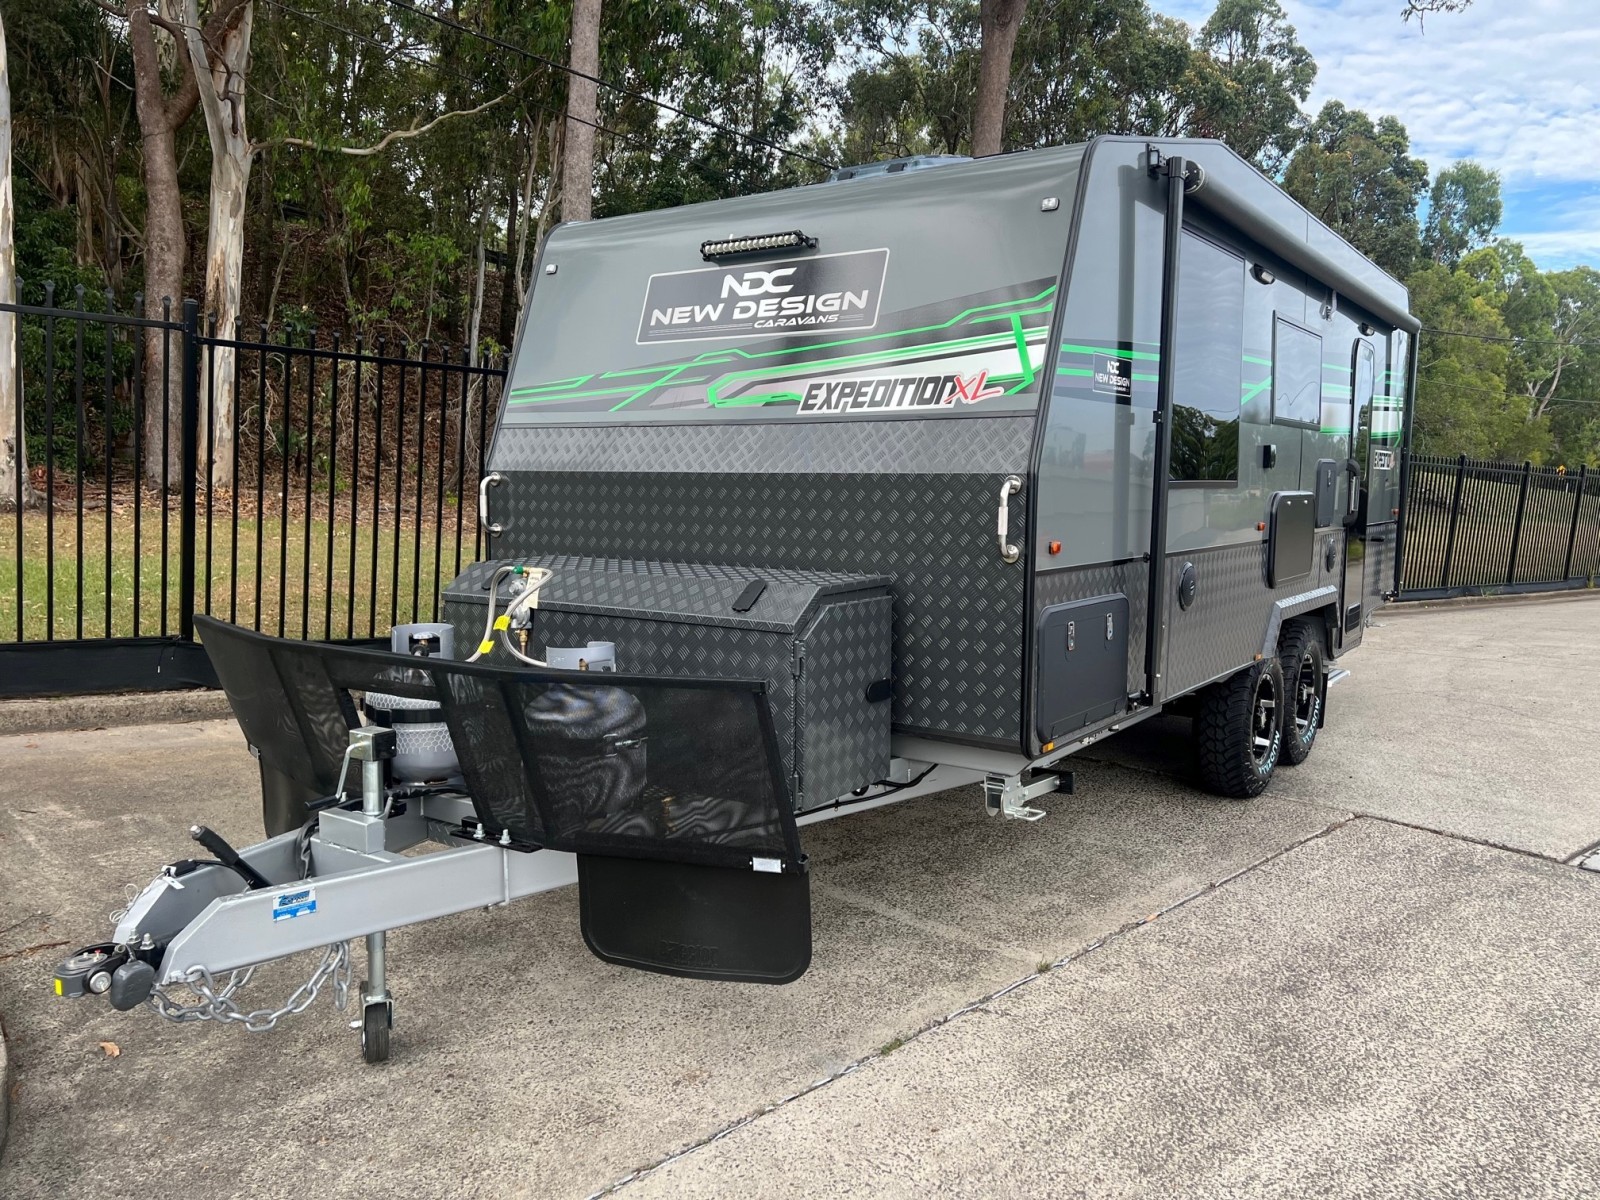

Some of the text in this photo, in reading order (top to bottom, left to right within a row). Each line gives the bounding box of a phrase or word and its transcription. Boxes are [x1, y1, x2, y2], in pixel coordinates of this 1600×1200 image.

[720, 267, 798, 299] NDC
[649, 289, 869, 327] NEW DESIGN
[753, 313, 840, 329] CARAVANS
[1095, 372, 1130, 387] NEW DESIGN
[1107, 360, 1120, 375] NDC
[800, 371, 1001, 412] EXPEDITION XL
